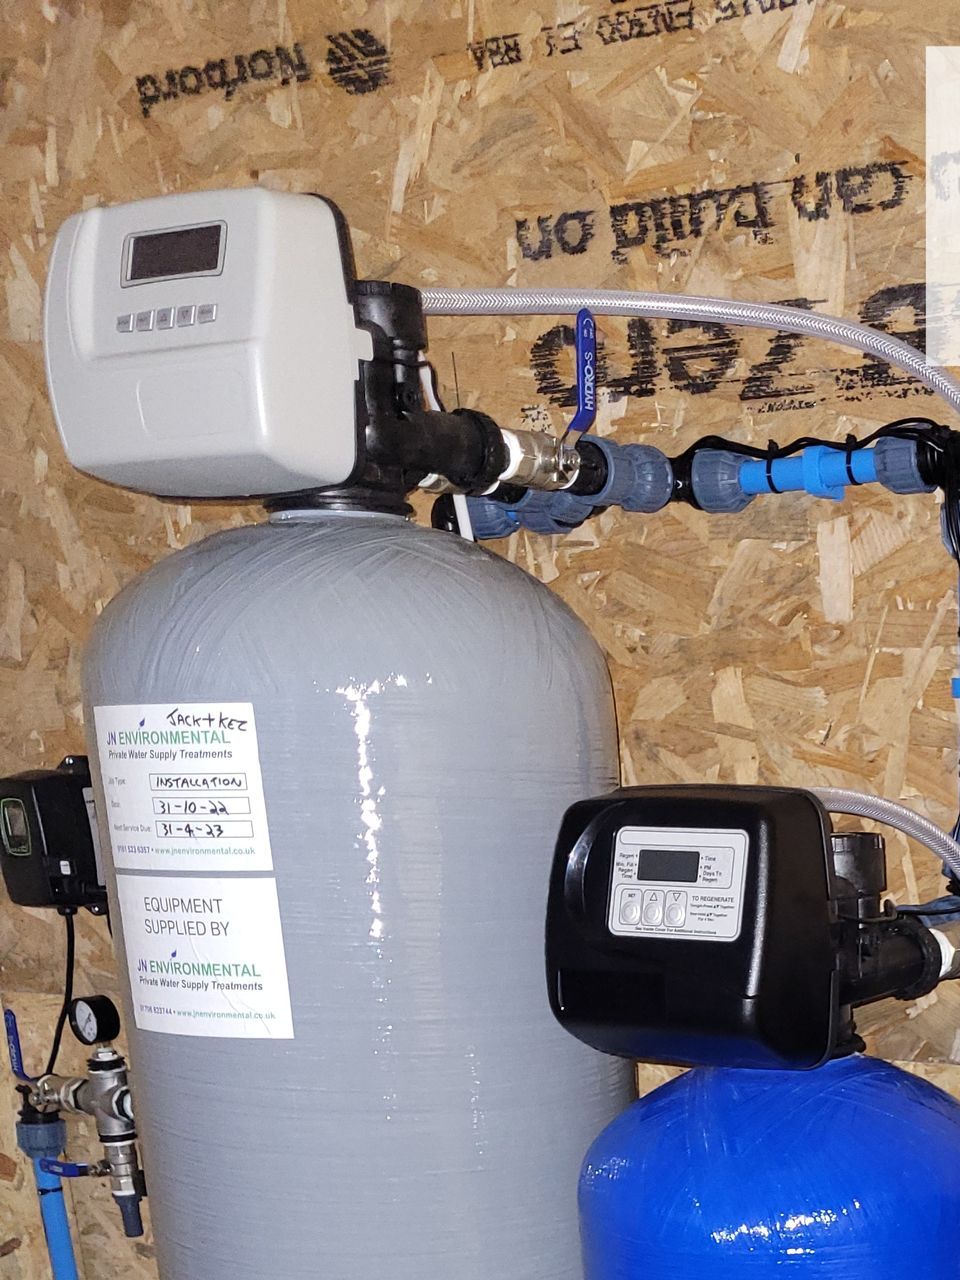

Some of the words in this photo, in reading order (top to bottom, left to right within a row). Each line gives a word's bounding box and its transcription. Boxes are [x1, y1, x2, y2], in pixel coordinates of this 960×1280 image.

[135, 42, 311, 119] Norbord
[515, 210, 596, 261] on
[584, 352, 595, 411] HYDRO-S
[106, 730, 117, 746] JN
[119, 730, 231, 745] ENVIRONMENTAL
[109, 750, 127, 760] Private
[129, 749, 147, 759] Water
[150, 749, 177, 761] Supply
[180, 749, 233, 759] Treatments
[144, 896, 223, 913] EQUIPMENT
[145, 918, 207, 936] SUPPLIED
[210, 921, 229, 936] BY
[137, 959, 148, 973] JN
[149, 960, 262, 977] ENVIRONMENTAL
[139, 976, 158, 986] Private
[160, 978, 179, 989] Water
[181, 980, 209, 991] Supply
[212, 980, 263, 991] Treatments
